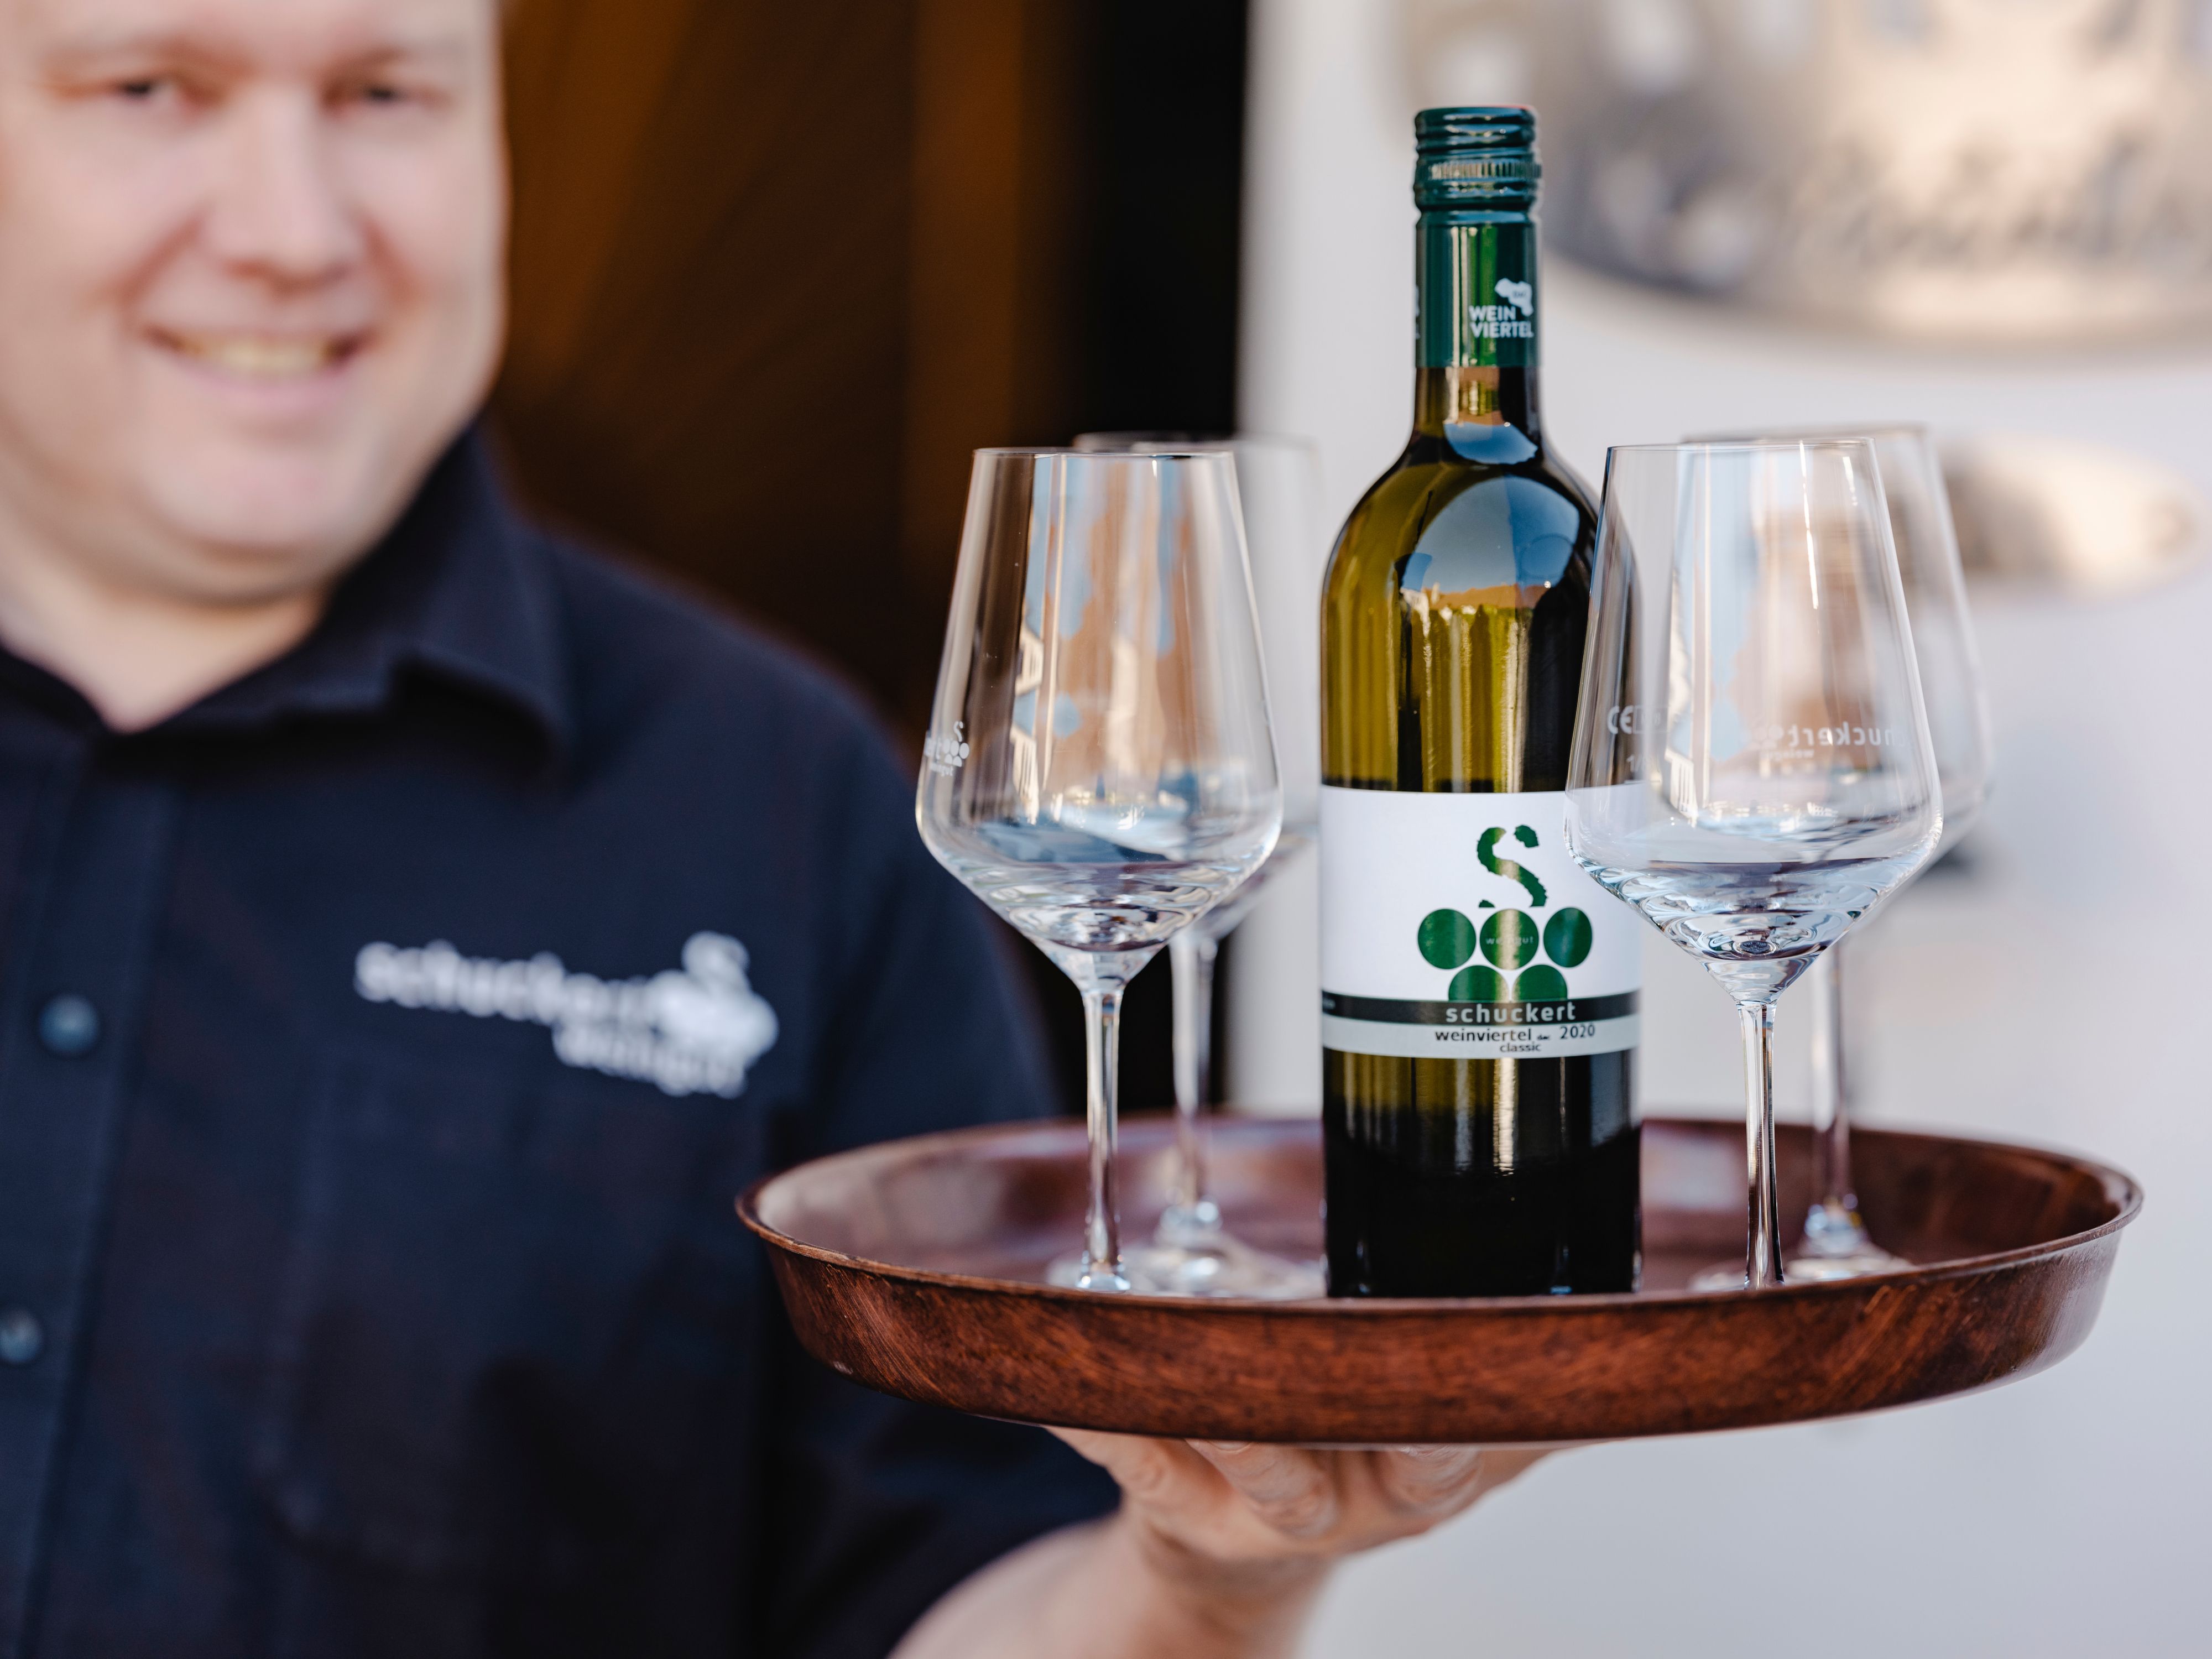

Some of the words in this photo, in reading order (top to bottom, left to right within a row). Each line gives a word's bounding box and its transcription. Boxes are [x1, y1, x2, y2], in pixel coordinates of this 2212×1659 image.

[1469, 305, 1516, 321] WEIN
[1470, 321, 1533, 338] VIERTEL
[1446, 1001, 1576, 1023] schuckert
[1436, 1027, 1531, 1041] weinviertel
[1559, 1024, 1595, 1039] 2020
[1500, 1042, 1541, 1052] classic
